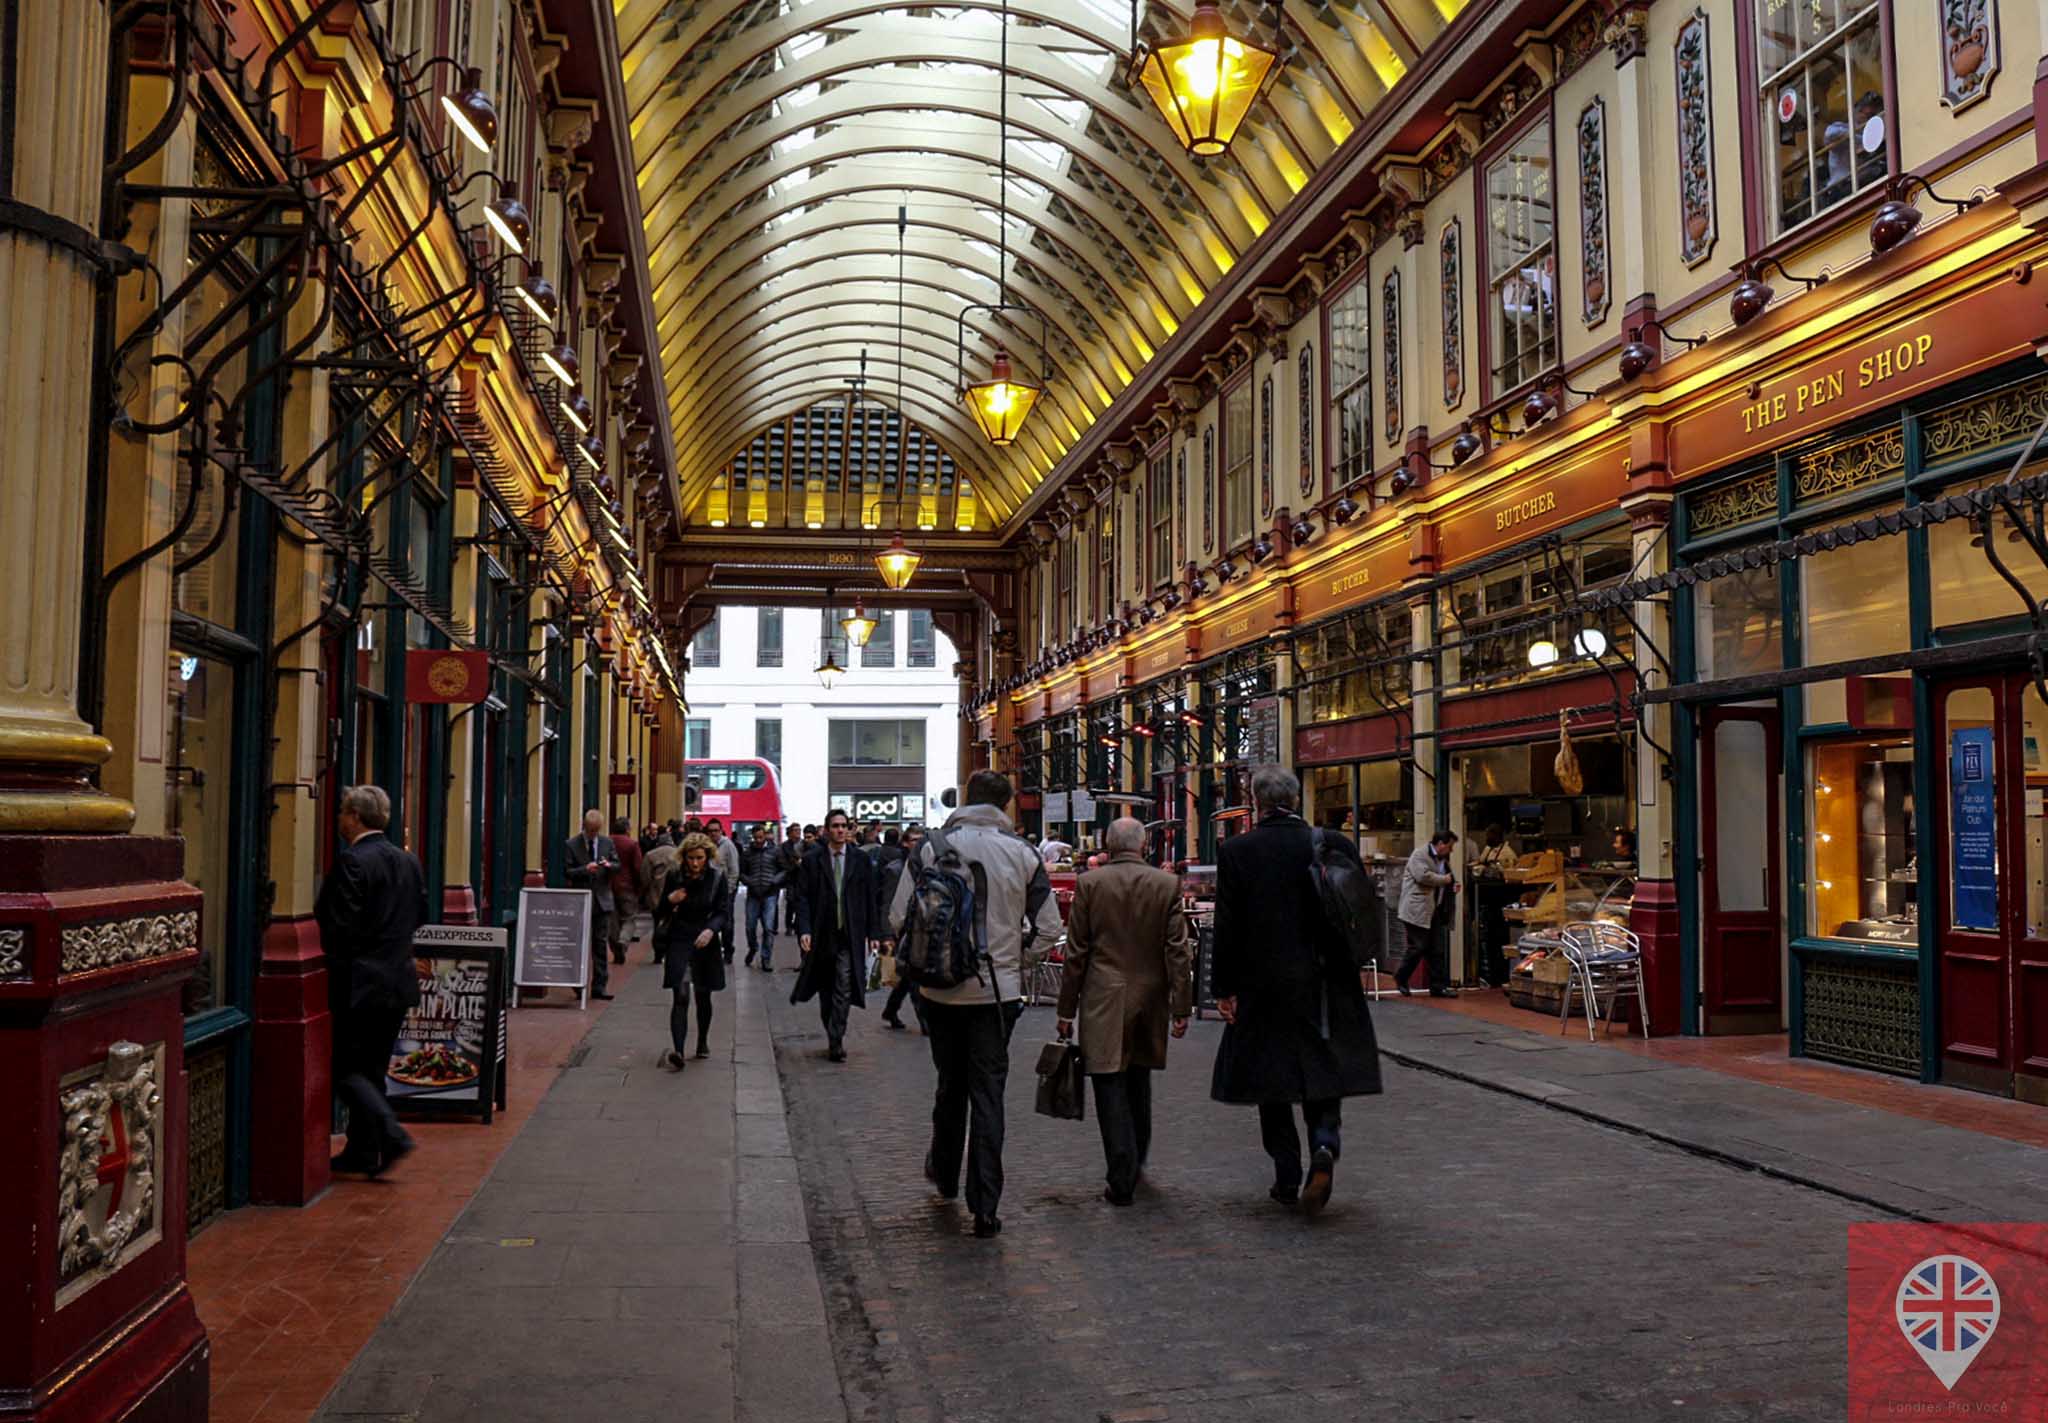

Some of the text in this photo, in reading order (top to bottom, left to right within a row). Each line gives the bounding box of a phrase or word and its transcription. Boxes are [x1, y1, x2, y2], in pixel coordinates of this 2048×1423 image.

[1742, 334, 1933, 433] THE PEN SHOP
[1496, 491, 1556, 531] BUTCHER
[1331, 568, 1370, 595] BUTCHER
[856, 796, 898, 819] pod
[441, 994, 486, 1020] PLATE
